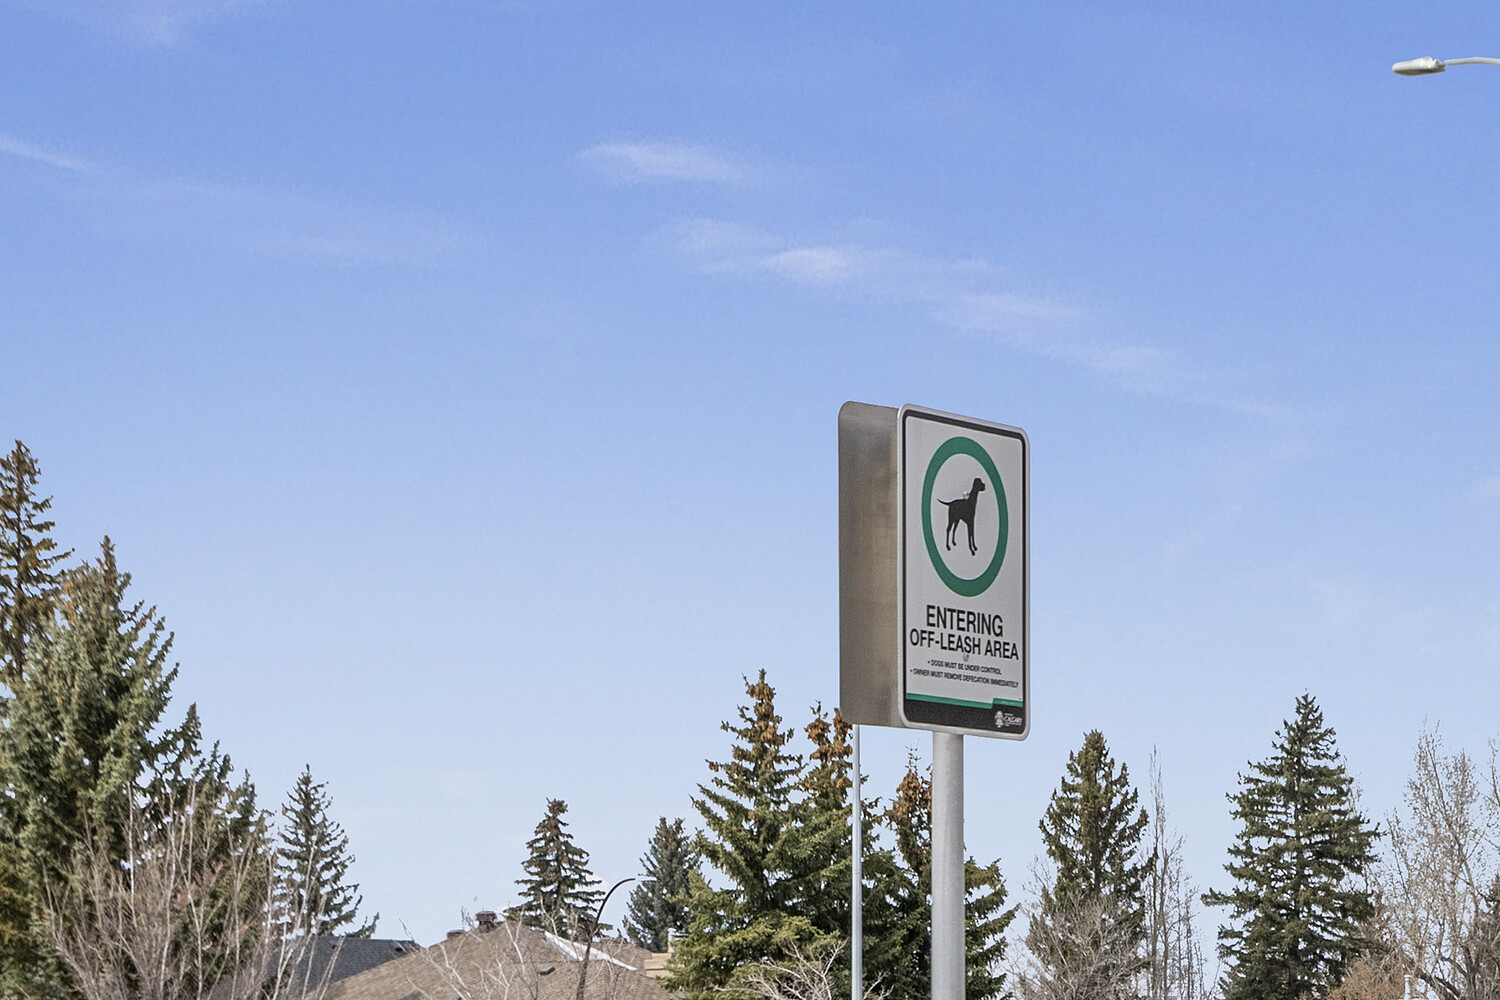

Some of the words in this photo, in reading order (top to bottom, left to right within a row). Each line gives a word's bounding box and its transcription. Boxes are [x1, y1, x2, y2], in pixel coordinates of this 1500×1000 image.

[926, 604, 1003, 638] ENTERING
[909, 628, 981, 655] OFF-LEASH
[984, 639, 1019, 661] AREA
[913, 667, 930, 676] OWNER
[930, 670, 943, 678] MUST
[943, 671, 962, 681] REMOVE
[962, 674, 990, 684] DEFECATION
[990, 678, 1019, 688] IMMEDIATELY
[930, 659, 944, 667] DOGS
[944, 661, 957, 669] MUST
[964, 664, 980, 672] UNDER
[980, 665, 1002, 675] CONTROL
